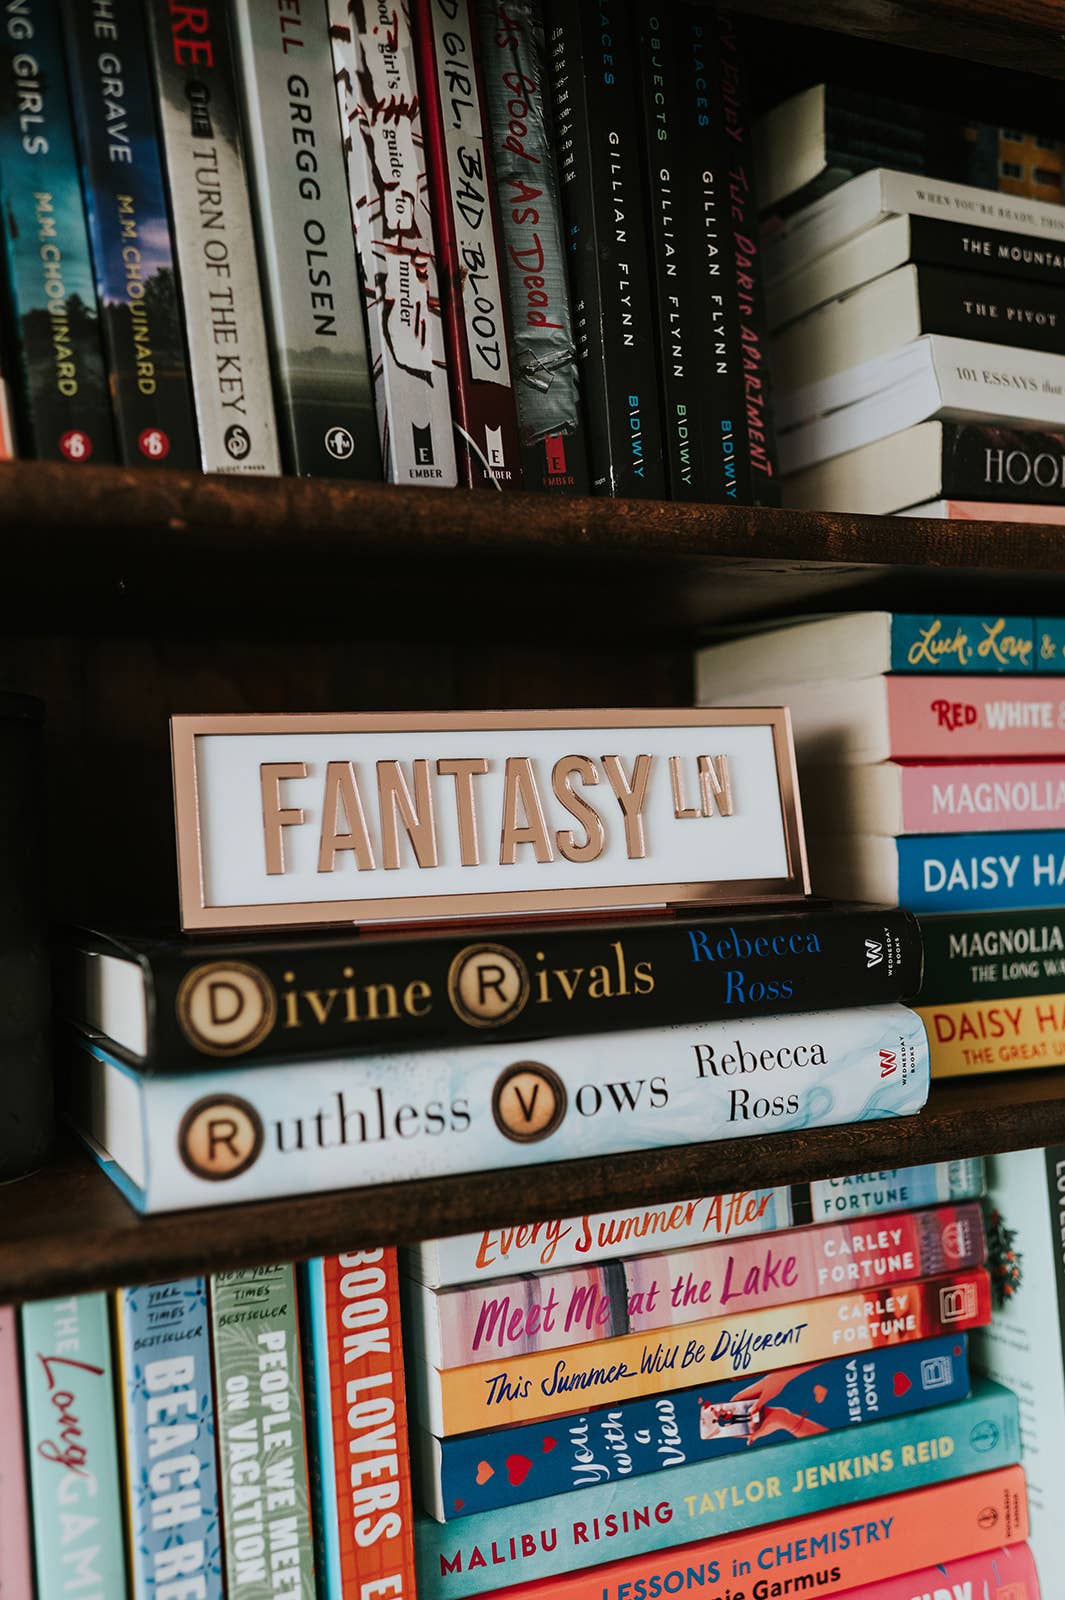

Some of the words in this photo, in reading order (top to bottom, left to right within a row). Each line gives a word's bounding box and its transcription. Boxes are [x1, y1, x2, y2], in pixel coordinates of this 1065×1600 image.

[168, 0, 214, 68] RE
[377, 43, 401, 90] girl's
[650, 16, 669, 142] OBJECTS
[691, 23, 710, 128] PLACES
[13, 53, 49, 156] GIRLS
[97, 52, 133, 164] GRAVE
[287, 73, 322, 201] GREGG
[382, 129, 402, 180] guide
[192, 147, 226, 232] TURN
[395, 196, 405, 215] to
[456, 145, 486, 232] BAD
[915, 190, 951, 206] WHEN
[953, 198, 995, 217] YOU'RE
[608, 131, 627, 243] GILLIAN
[618, 262, 635, 348] FLYNN
[659, 168, 678, 277] GILLIAN
[961, 237, 992, 257] THE
[203, 239, 232, 280] OF
[303, 218, 338, 337] OLSEN
[509, 232, 566, 331] Dead
[701, 170, 721, 276] GILLIAN
[711, 294, 728, 375] FLYNN
[40, 243, 78, 397] CHOUINARD
[121, 244, 157, 396] CHOUINARD
[208, 287, 240, 345] THE
[399, 261, 415, 328] murder
[460, 241, 502, 372] BLOOD
[963, 300, 998, 318] THE
[1006, 306, 1058, 328] PIVOT
[667, 295, 685, 378] FLYNN
[216, 353, 248, 417] KEY
[740, 325, 773, 478] APARTMENT
[956, 366, 977, 383] 101
[982, 370, 1039, 392] ESSAYS
[1042, 379, 1063, 396] that
[409, 468, 443, 479] EMBER
[543, 476, 575, 486] EMBER
[983, 447, 1065, 490] HOO
[907, 619, 974, 666] Luck,
[977, 617, 1033, 666] Love
[984, 701, 1054, 731] WHITE
[260, 753, 653, 876] FANTASY
[670, 753, 733, 819] LN
[931, 780, 1065, 816] MAGNOLIA
[923, 854, 1021, 893] DAISY
[688, 926, 824, 964] Rebecca
[884, 927, 894, 977] WEDNESDAY
[894, 937, 902, 965] BOOKS
[949, 925, 1065, 960] MAGNOLIA
[970, 963, 998, 983] THE
[1001, 958, 1040, 981] LONG
[190, 963, 434, 1044] Divine
[460, 940, 656, 1018] Rivals
[723, 969, 796, 1005] Ross
[932, 1005, 1023, 1045] DAISY
[692, 1038, 829, 1080] Rebecca
[899, 1035, 908, 1086] WEDNESDAY
[961, 1047, 995, 1068] THE
[998, 1041, 1048, 1063] GREAT
[193, 1088, 472, 1172] Ruthless
[501, 1066, 671, 1133] Vows
[725, 1087, 801, 1124] Ross
[823, 1186, 910, 1213] FORTUNE
[474, 1218, 572, 1270] Every
[574, 1197, 703, 1253] Summer
[702, 1191, 775, 1237] After
[823, 1228, 903, 1258] CARLEY
[148, 1287, 181, 1303] YORK
[232, 1285, 271, 1301] TIMES
[816, 1251, 915, 1286] FORTUNE
[52, 1296, 81, 1353] THE
[147, 1306, 185, 1323] TIMES
[218, 1303, 289, 1328] BESTSELLER
[338, 1246, 391, 1365] BOOK
[471, 1287, 556, 1352] Meet
[563, 1276, 611, 1343] Me
[626, 1278, 659, 1318] at
[670, 1270, 712, 1309] the
[719, 1248, 799, 1306] Lake
[836, 1294, 908, 1322] CARLEY
[133, 1325, 204, 1351] BESTSELLER
[831, 1315, 918, 1346] FORTUNE
[257, 1328, 293, 1453] PEOPLE
[484, 1372, 534, 1407] This
[541, 1359, 638, 1397] Summer
[641, 1342, 677, 1375] Will
[681, 1342, 706, 1367] Be
[710, 1322, 809, 1373] Different
[844, 1359, 863, 1423] JESSICA
[862, 1361, 880, 1412] JOYCE
[36, 1353, 105, 1479] Long
[224, 1374, 250, 1412] ON
[144, 1354, 201, 1532] BEACH
[345, 1370, 402, 1548] LOVERS
[568, 1416, 611, 1487] You,
[600, 1410, 633, 1475] with
[634, 1428, 652, 1445] a
[655, 1399, 687, 1467] View
[227, 1417, 267, 1586] VACATION
[265, 1456, 296, 1511] WE
[438, 1526, 558, 1578] MALIBU
[573, 1500, 674, 1546] RISING
[683, 1475, 783, 1519] TAYLOR
[790, 1447, 895, 1495] JENKINS
[900, 1434, 956, 1469] REID
[57, 1471, 106, 1600] GAM
[731, 1558, 751, 1578] in
[755, 1517, 895, 1570] CHEMISTRY
[751, 1566, 842, 1600] Garmus
